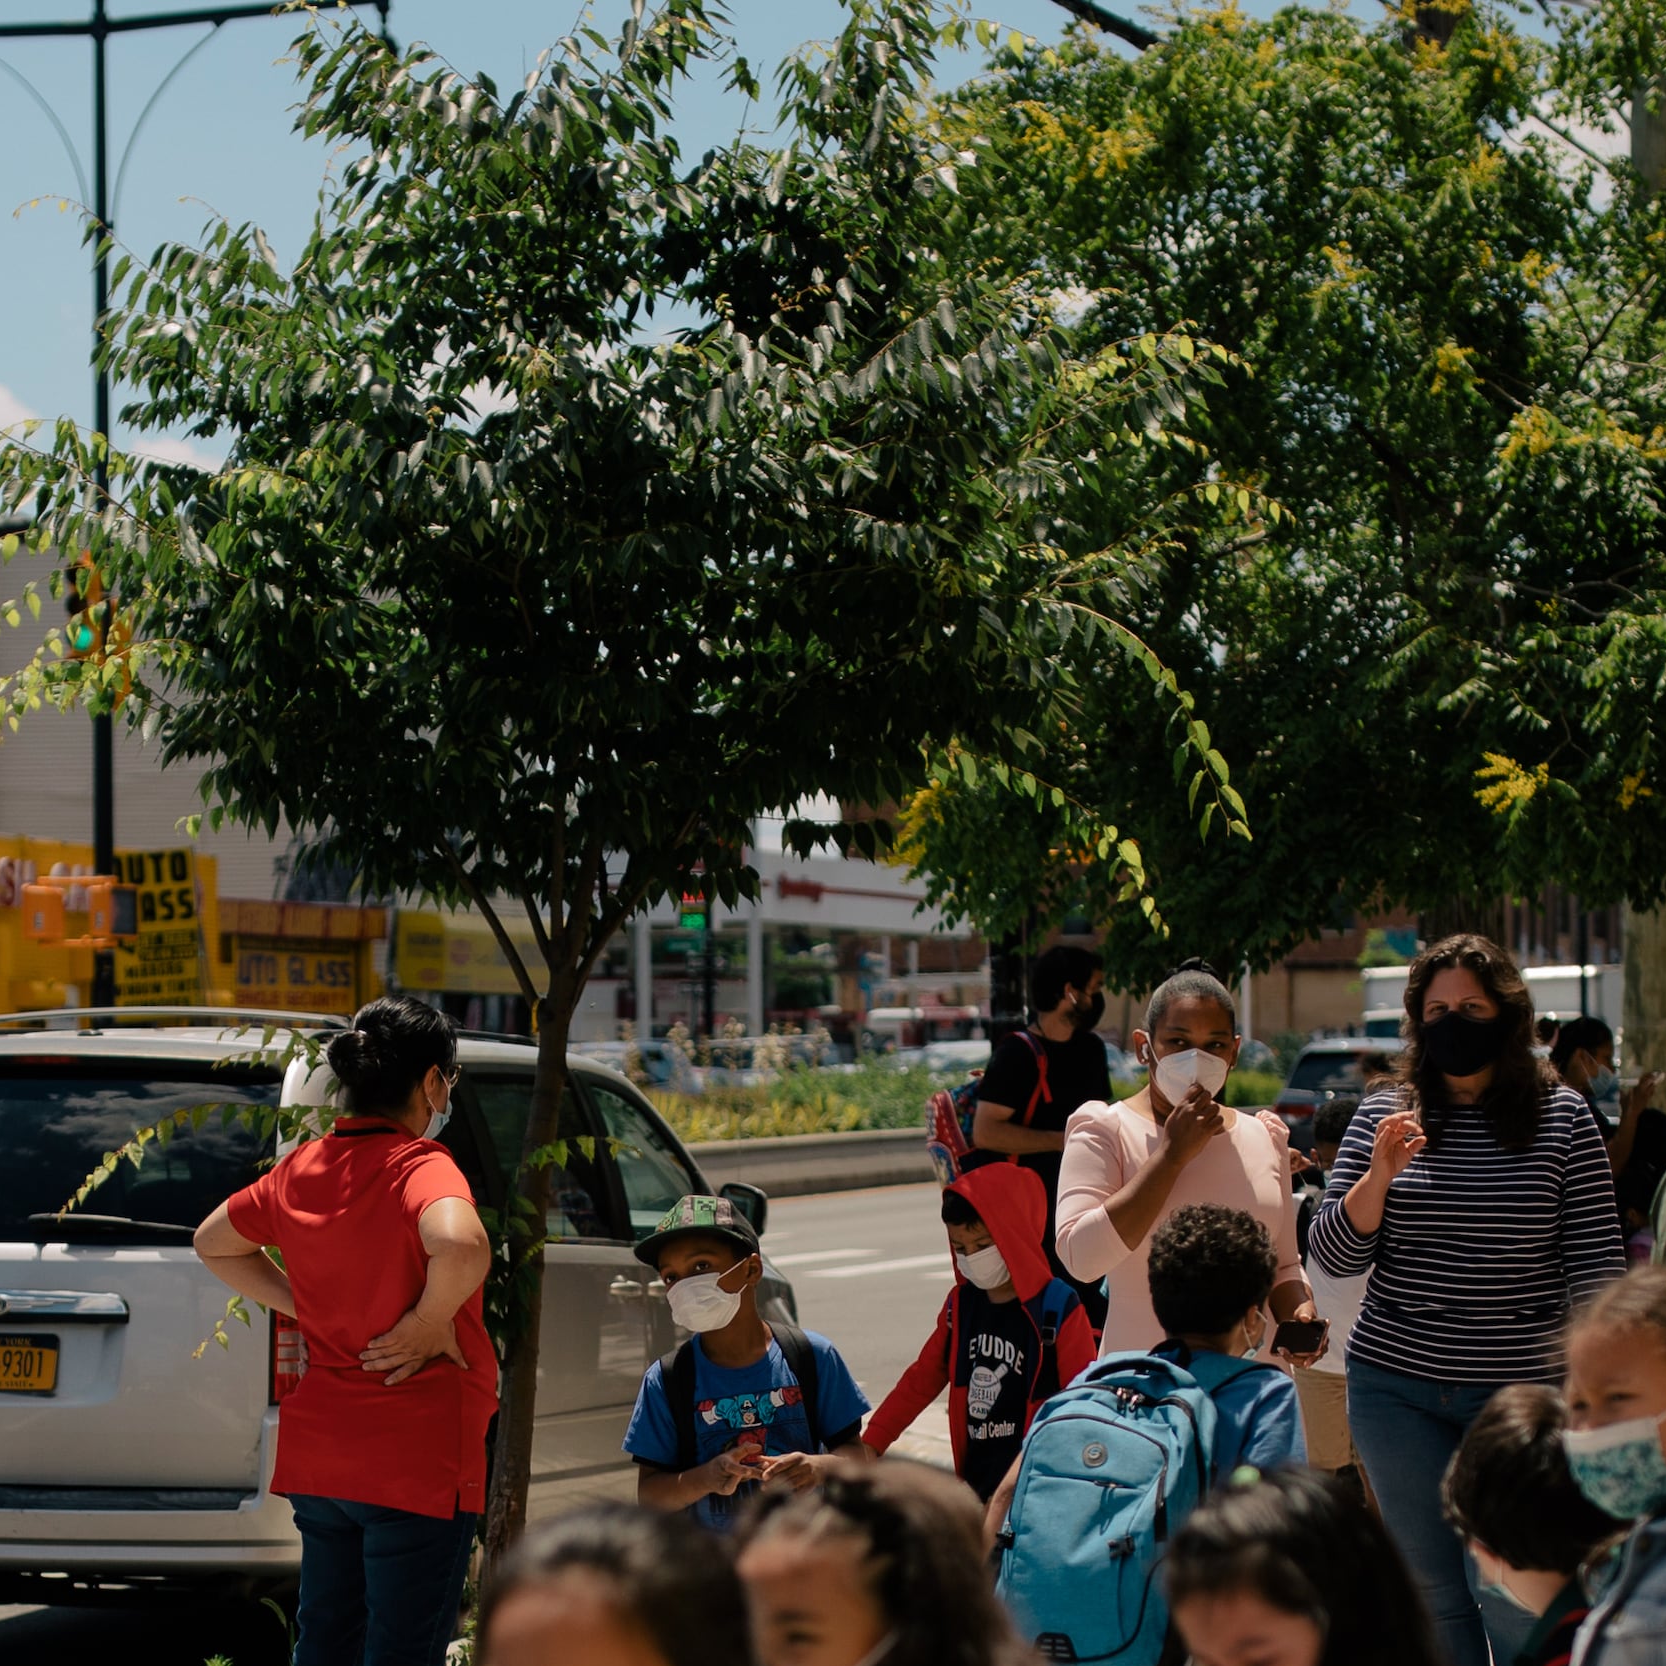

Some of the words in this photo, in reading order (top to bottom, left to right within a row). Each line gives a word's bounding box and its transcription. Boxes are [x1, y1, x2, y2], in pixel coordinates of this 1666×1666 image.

[287, 954, 352, 987] GLASS
[4, 1336, 32, 1346] YORK
[2, 1349, 44, 1378] 9301
[988, 1419, 1016, 1439] Center
